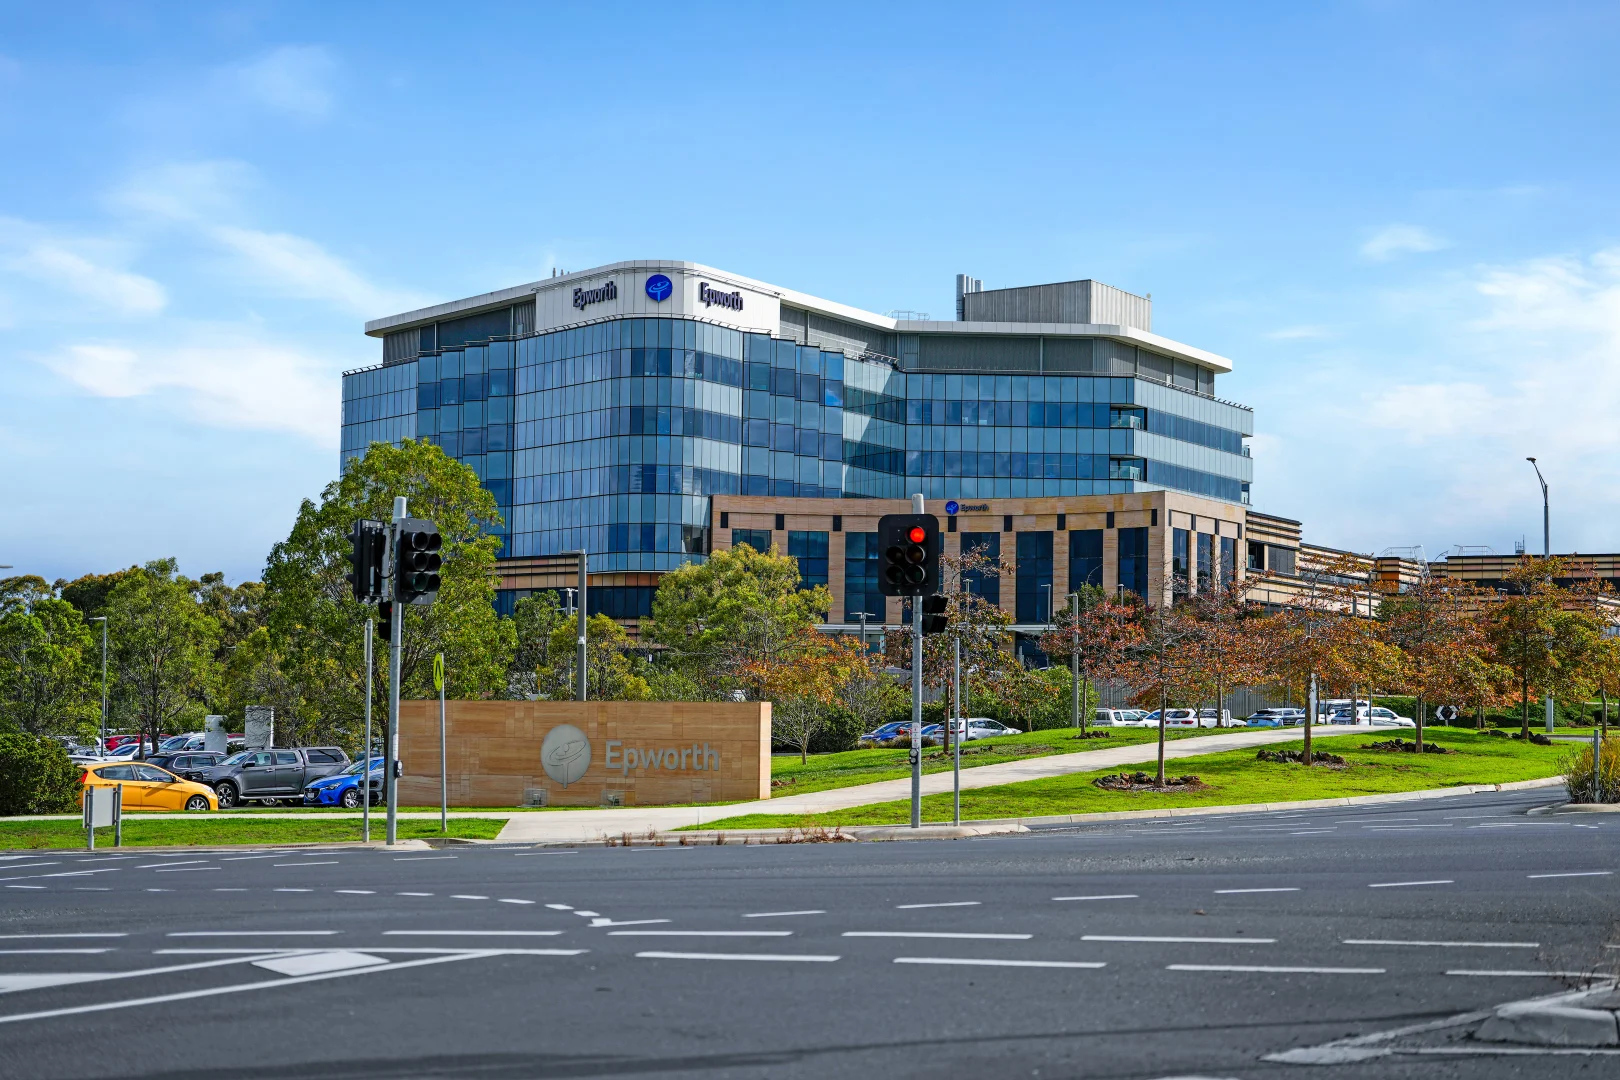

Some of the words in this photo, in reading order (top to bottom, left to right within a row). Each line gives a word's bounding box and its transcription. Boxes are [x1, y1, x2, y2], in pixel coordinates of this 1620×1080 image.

[573, 281, 617, 310] Epworth
[698, 281, 743, 311] Epworth
[960, 504, 989, 512] Epworth
[605, 740, 719, 777] Epworth
